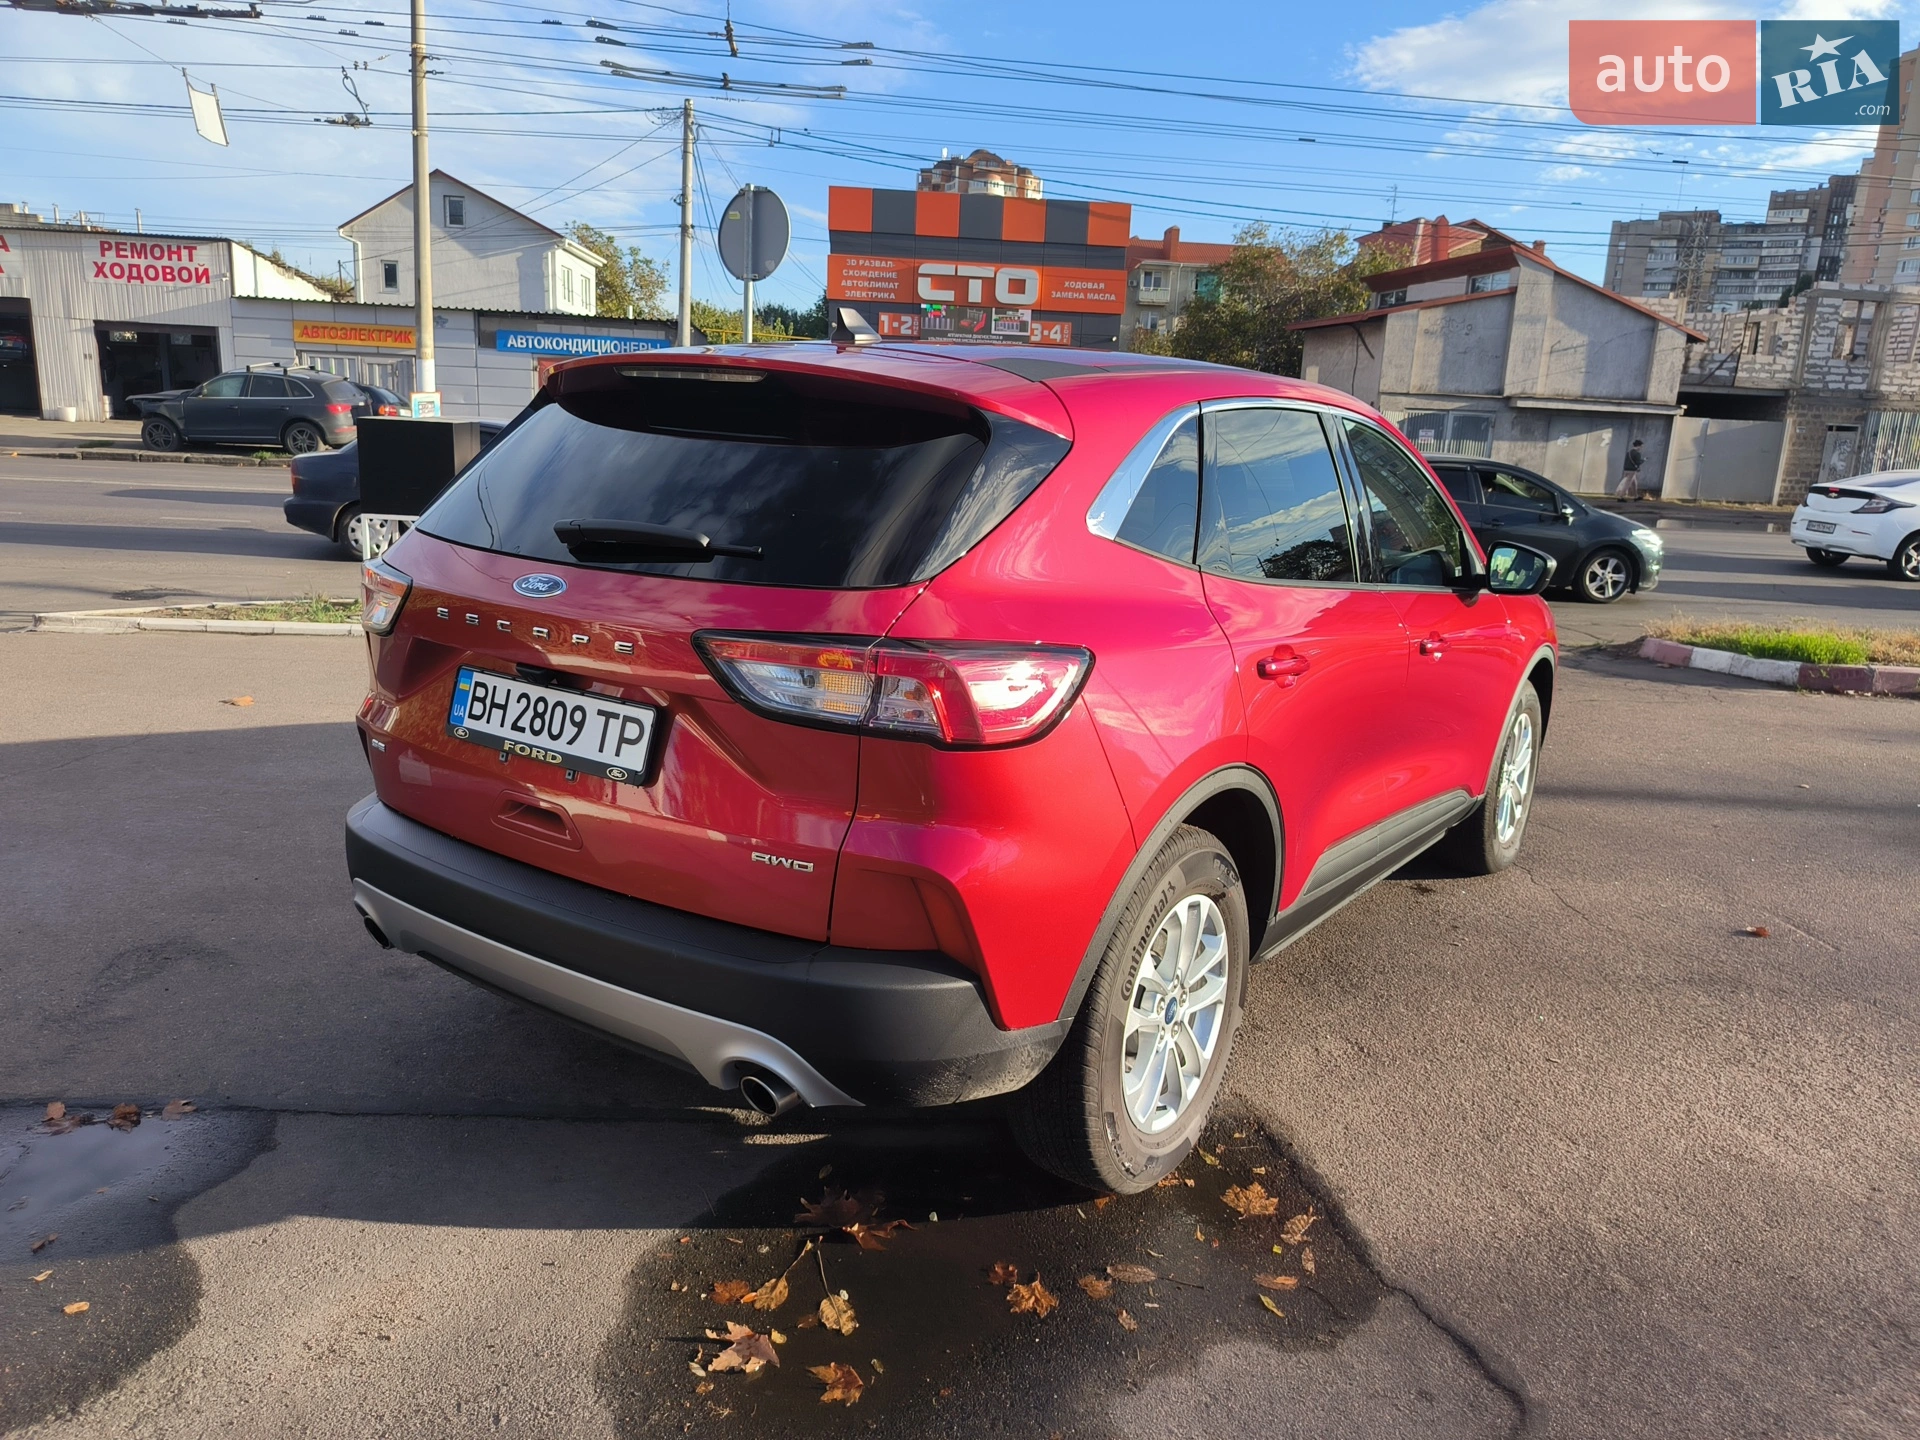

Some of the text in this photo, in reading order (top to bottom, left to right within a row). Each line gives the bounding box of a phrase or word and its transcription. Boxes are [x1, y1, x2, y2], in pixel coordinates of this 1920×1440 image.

[99, 240, 197, 263] РЕМОНТ
[93, 261, 210, 284] ХОДОВОЙ
[846, 259, 896, 268] 3D РАЗВАЛ-
[842, 269, 898, 279] СХОЖДЕНИЕ
[841, 280, 899, 289] АВТОКЛИМАТ
[917, 263, 1039, 305] СТО
[1064, 281, 1105, 290] ХОДОВАЯ
[845, 290, 896, 299] ЭЛЕКТРИКА
[1051, 291, 1116, 301] ЗАМЕНА МАСЛА
[300, 325, 413, 344] АВТОЭЛЕКТРИК
[880, 315, 912, 335] 1-2
[1031, 323, 1062, 343] 3-4
[437, 607, 634, 655] ESCAPE
[453, 703, 464, 718] UA
[503, 740, 562, 764] FORD
[1121, 889, 1169, 1001] Continental
